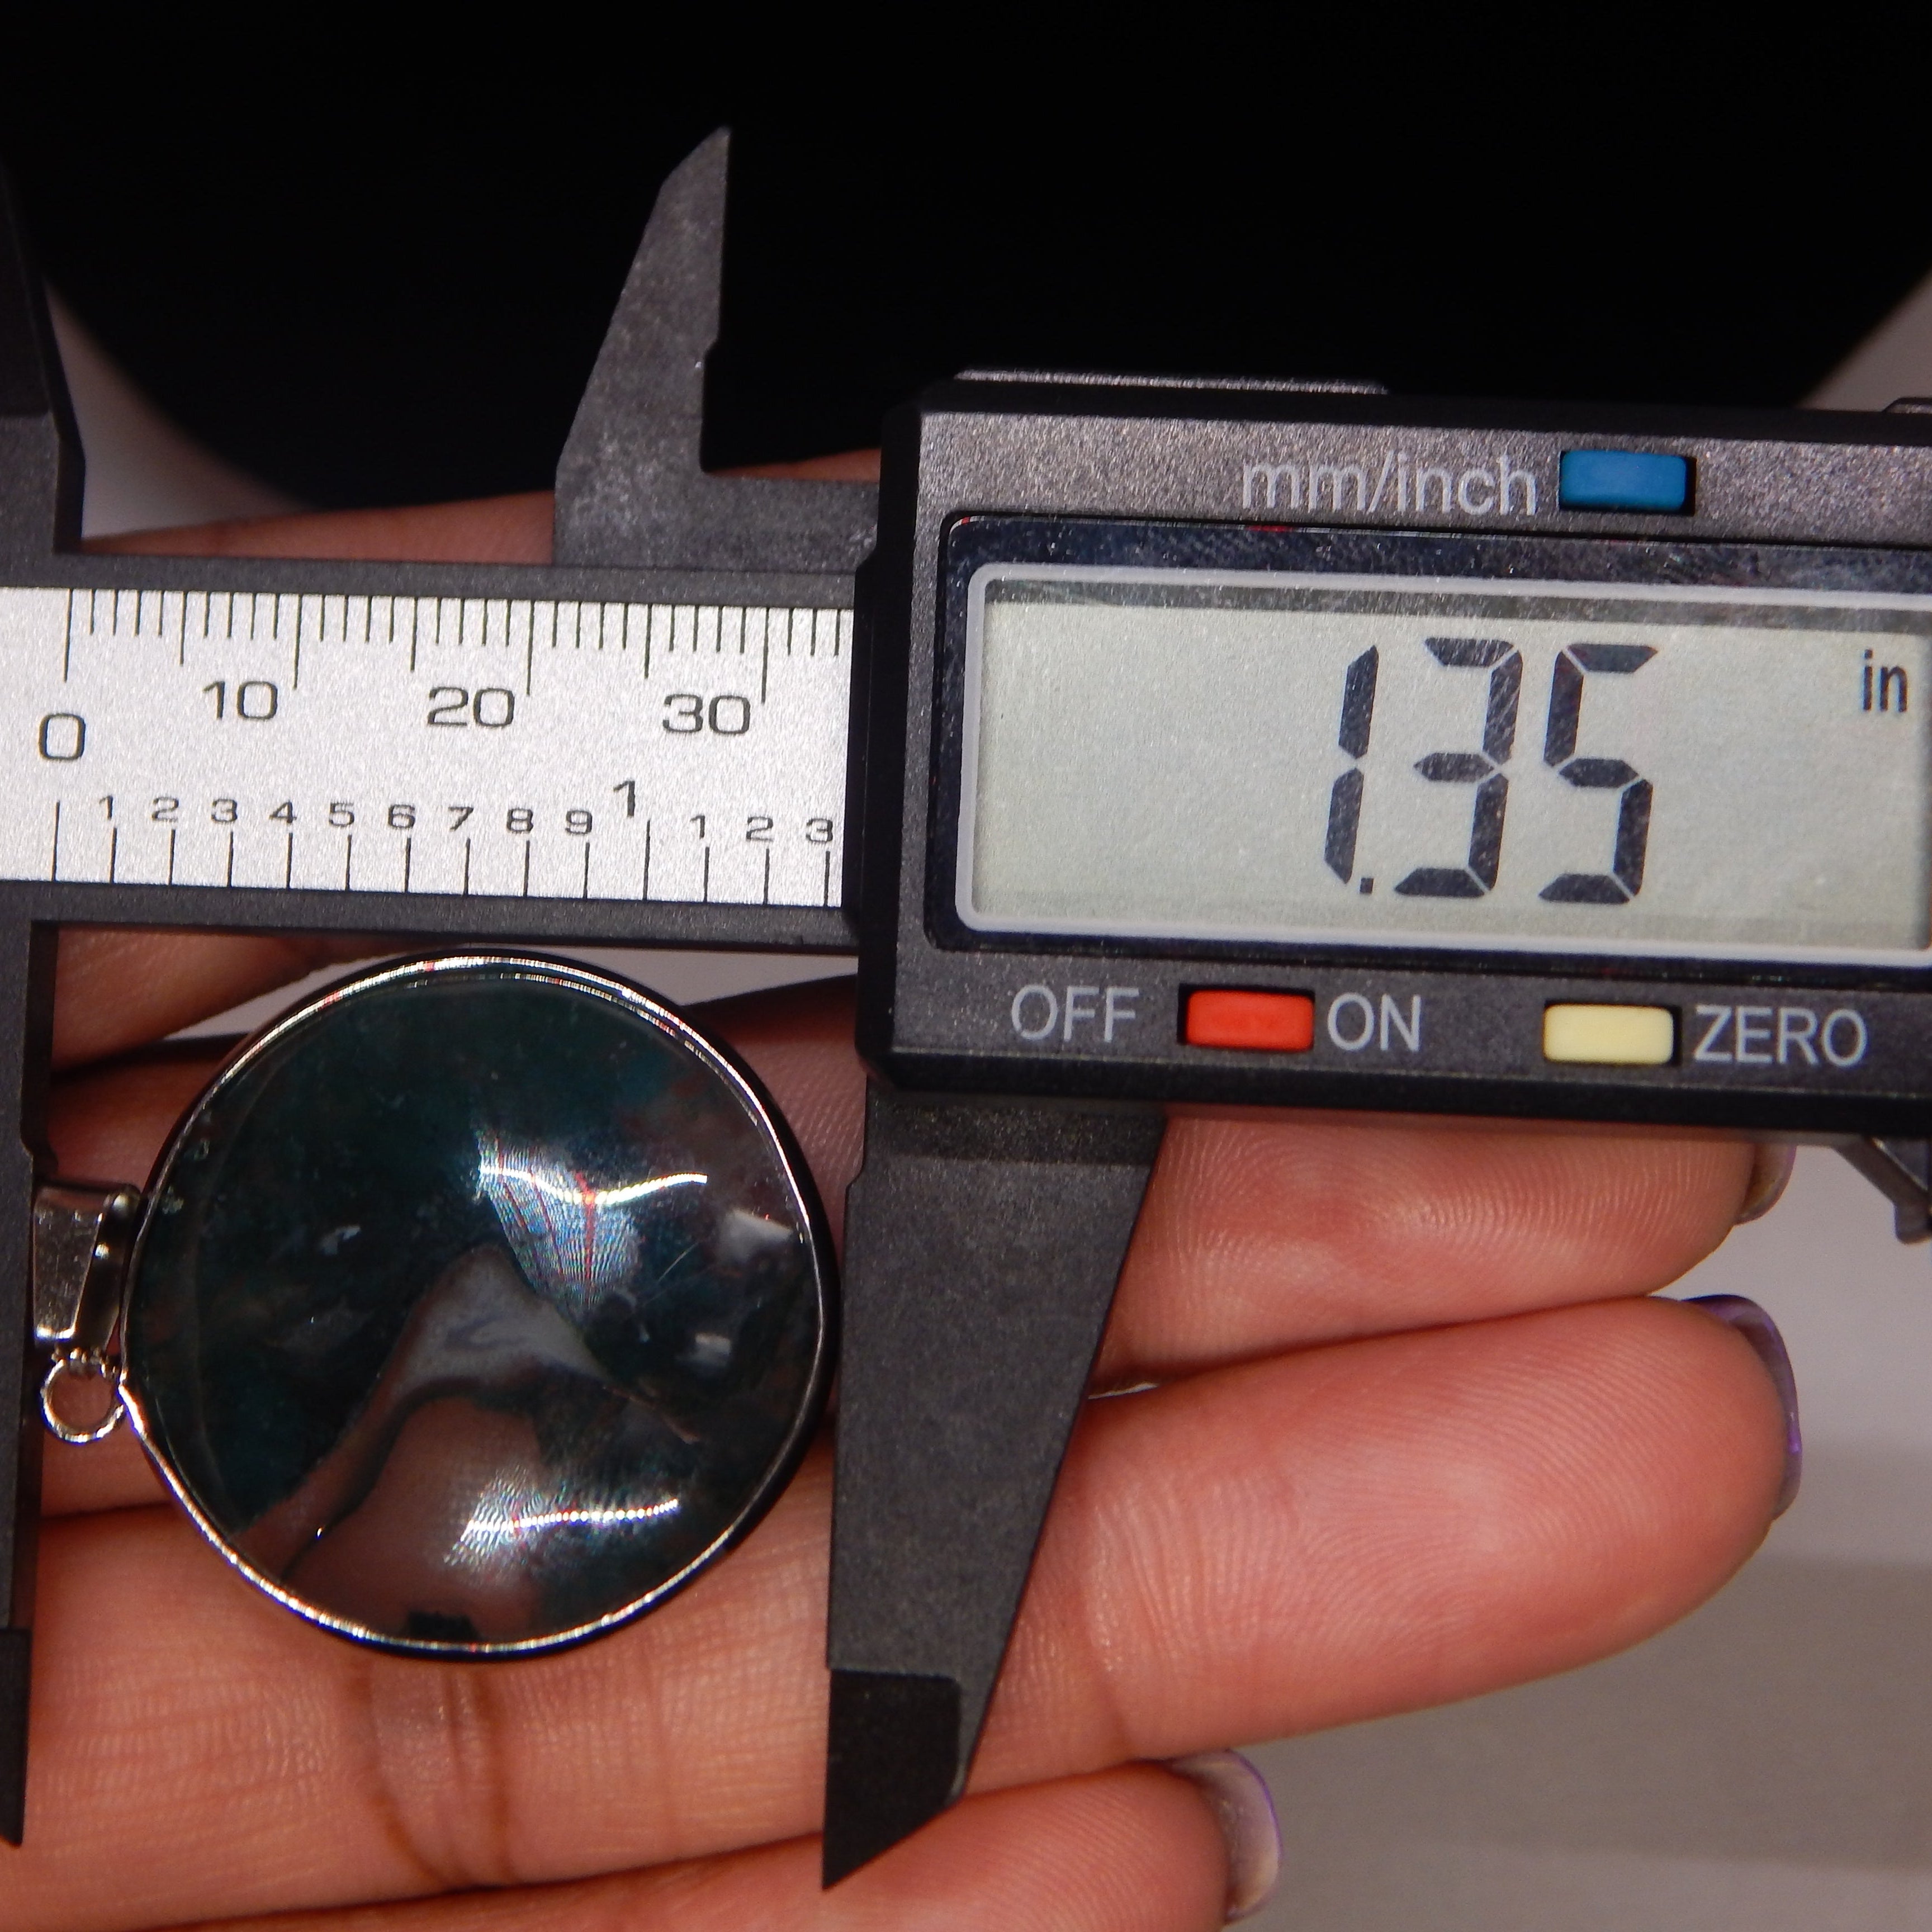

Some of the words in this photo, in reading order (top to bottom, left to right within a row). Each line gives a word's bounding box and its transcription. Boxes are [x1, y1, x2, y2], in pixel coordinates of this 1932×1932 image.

[1240, 448, 1538, 518] mm/inch
[37, 712, 87, 763] 0
[203, 680, 279, 722] 10
[427, 685, 516, 730] 20
[661, 693, 752, 737] 30
[1324, 636, 1659, 905] 1.35
[1862, 648, 1909, 714] in
[98, 794, 115, 821] 1
[150, 795, 181, 823] 2
[210, 797, 239, 825] 3
[269, 799, 298, 826] 4
[328, 801, 356, 830] 5
[387, 803, 416, 831] 6
[448, 805, 475, 832] 7
[505, 807, 535, 835] 8
[564, 808, 594, 837] 9
[613, 779, 637, 818] 1
[690, 813, 707, 840] 1
[745, 815, 775, 843] 2
[804, 817, 835, 845] 3
[1008, 984, 1142, 1044] OFF
[1326, 992, 1422, 1052] ON
[1692, 1003, 1867, 1067] ZERO
